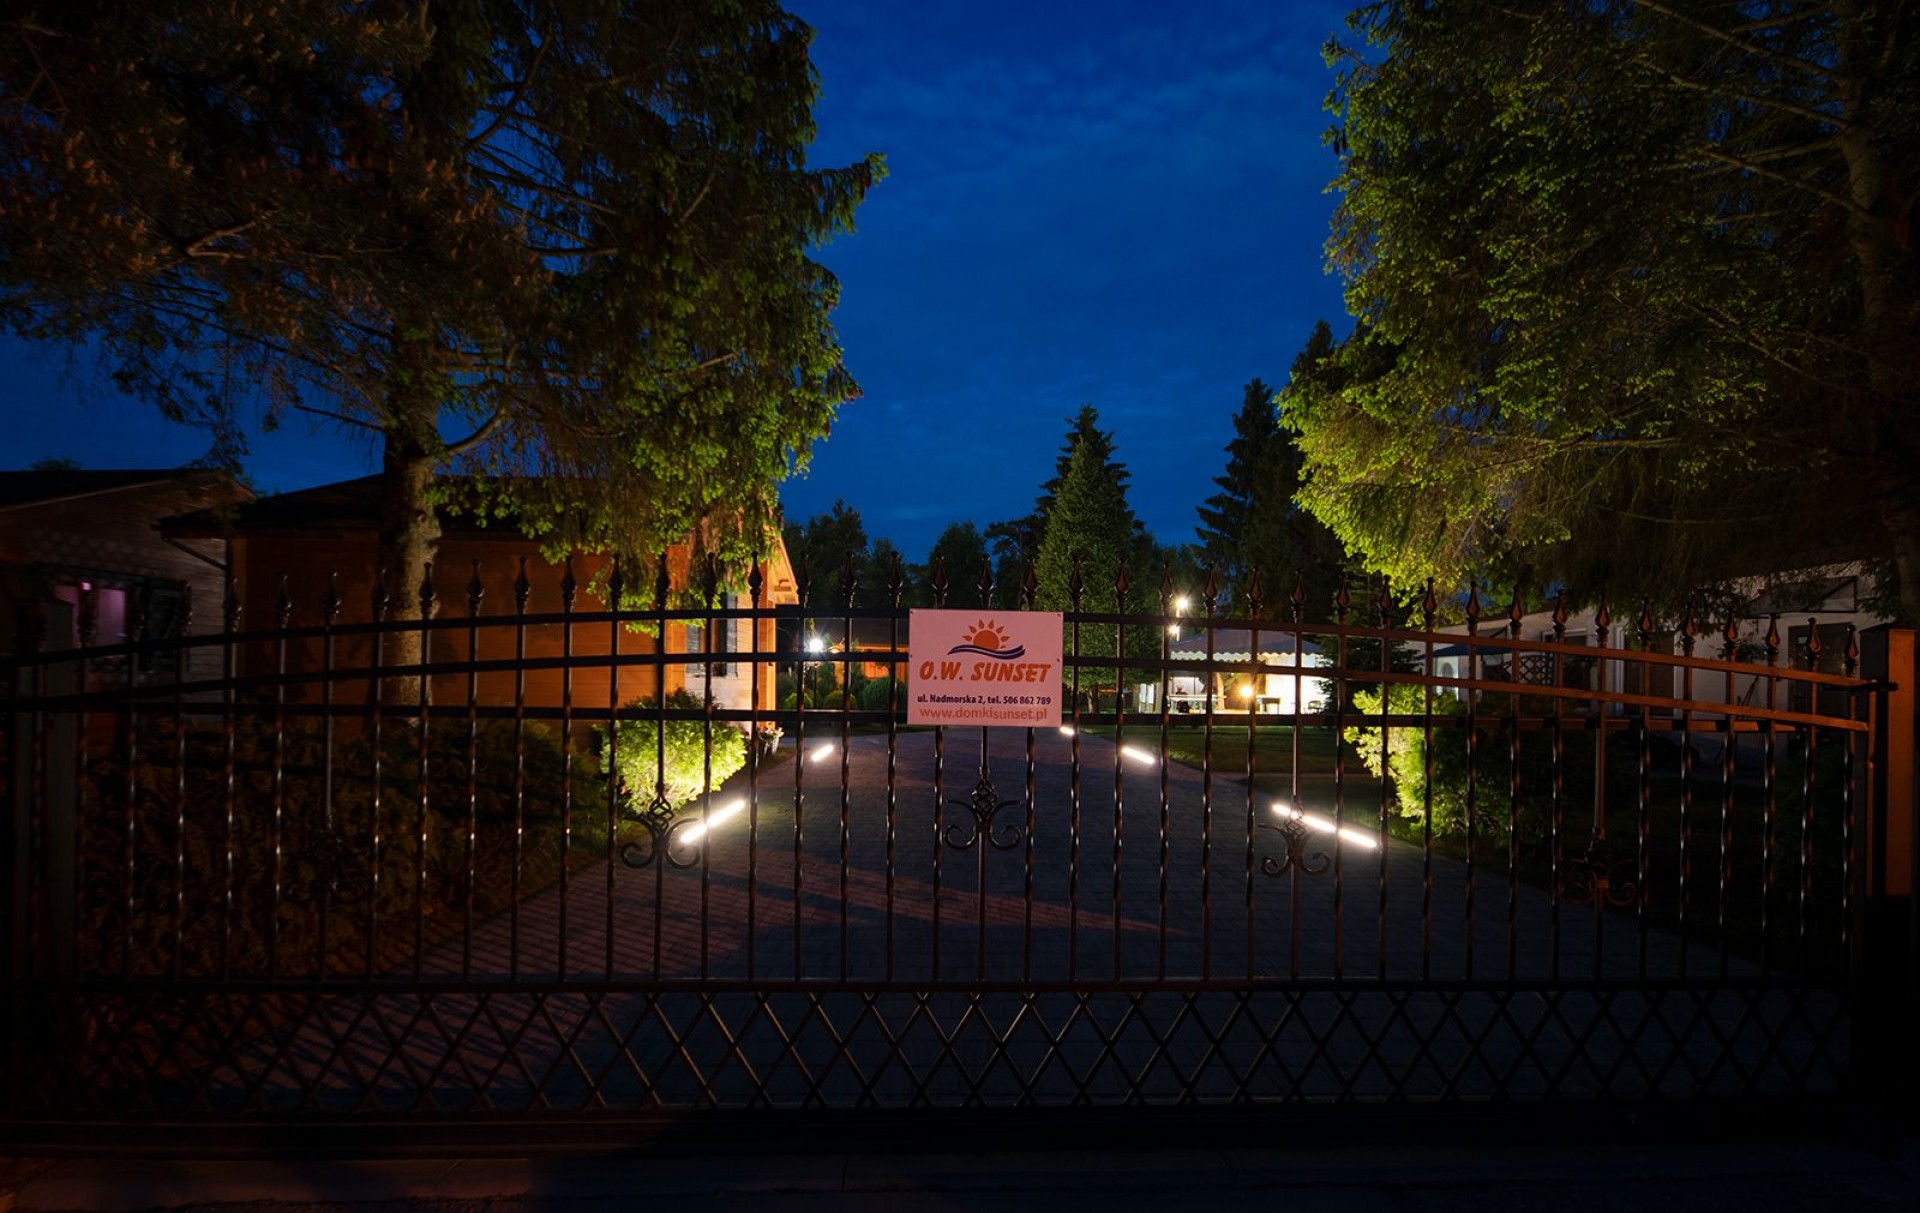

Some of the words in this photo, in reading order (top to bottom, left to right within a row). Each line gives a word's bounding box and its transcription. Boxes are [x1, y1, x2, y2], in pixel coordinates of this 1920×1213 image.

[919, 660, 963, 681] O.W.
[971, 661, 1051, 682] SUNSET
[917, 695, 928, 703] ul.
[930, 694, 976, 704] Nadmorska
[978, 695, 985, 705] 2,
[988, 695, 1001, 705] tel.
[1003, 695, 1018, 705] 506
[1020, 696, 1034, 705] 862
[1036, 696, 1051, 705] 789
[919, 706, 1047, 722] www.domkisunset.pl
